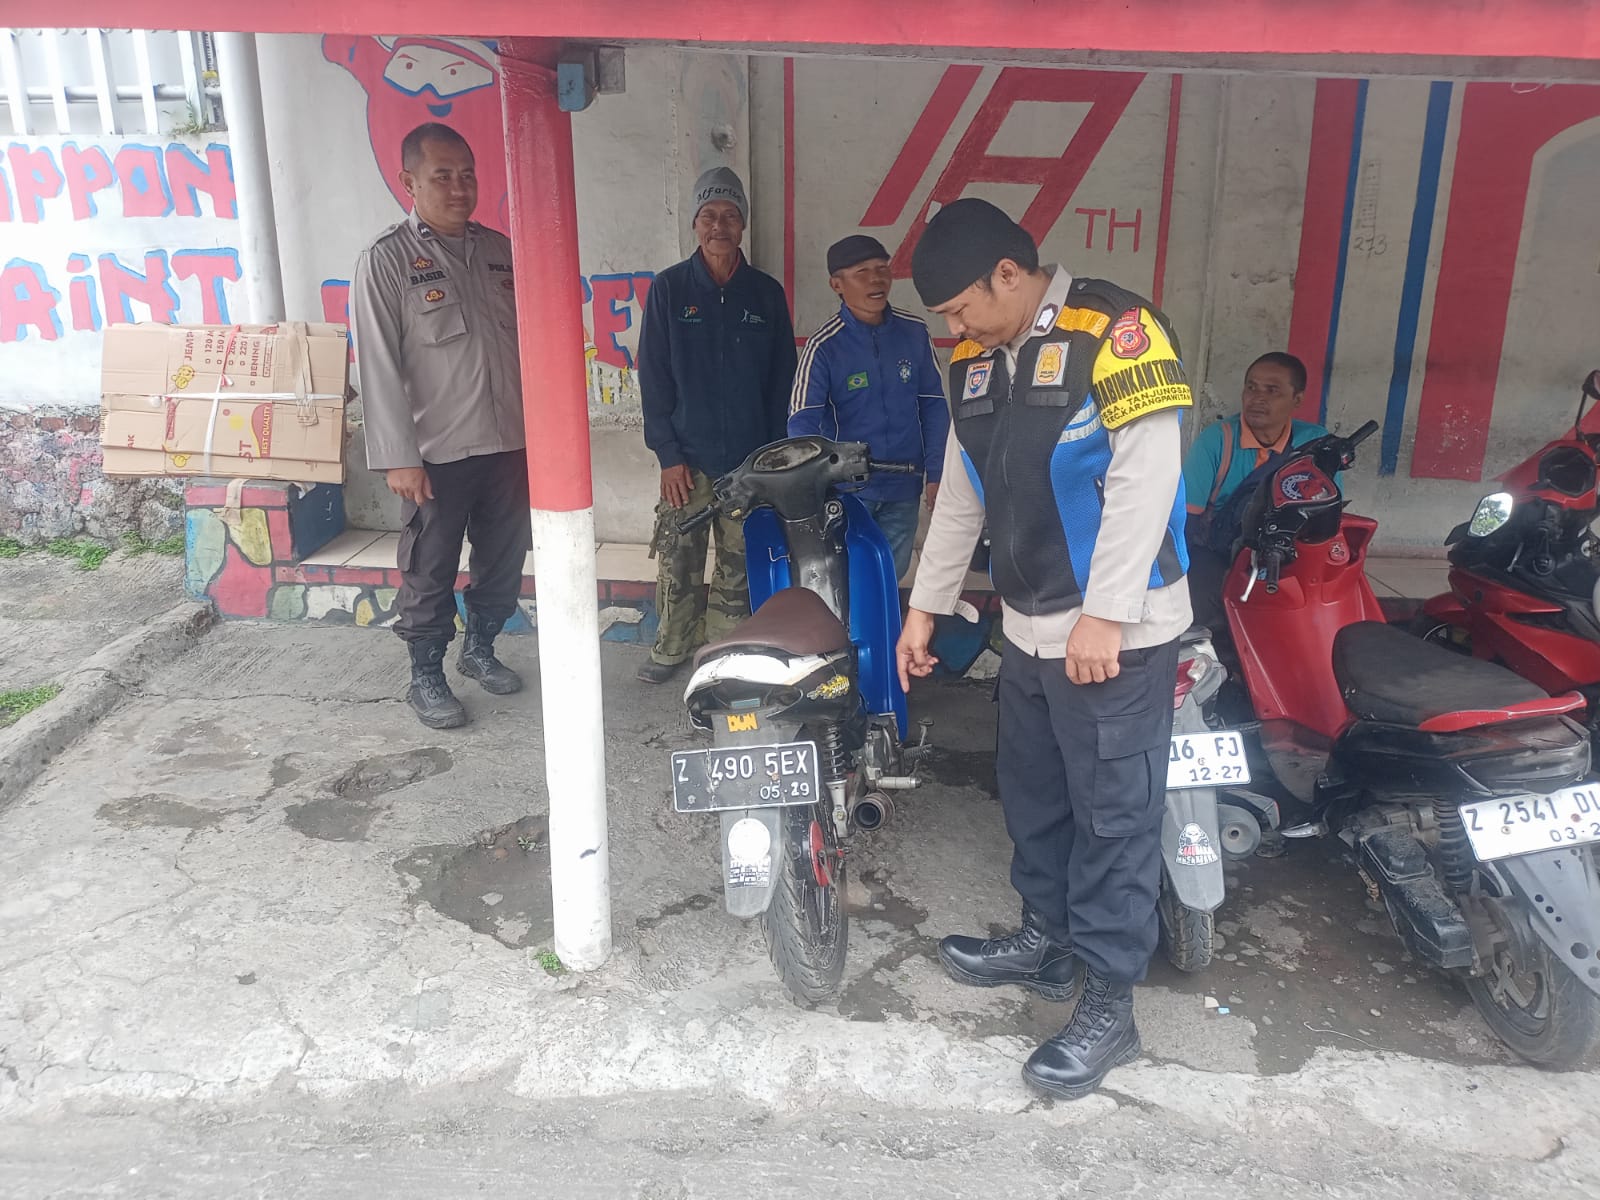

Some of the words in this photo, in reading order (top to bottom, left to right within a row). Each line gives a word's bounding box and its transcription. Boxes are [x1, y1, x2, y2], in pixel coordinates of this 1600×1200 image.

[1075, 208, 1143, 253] TH
[204, 336, 213, 353] 120
[216, 337, 224, 354] 150
[239, 338, 248, 356] 220
[250, 340, 261, 377] BENING
[262, 405, 271, 437] QUALITY
[1214, 737, 1239, 756] FJ
[765, 750, 808, 777] 5EX
[1465, 808, 1484, 831] Z
[1499, 796, 1558, 825] 2541
